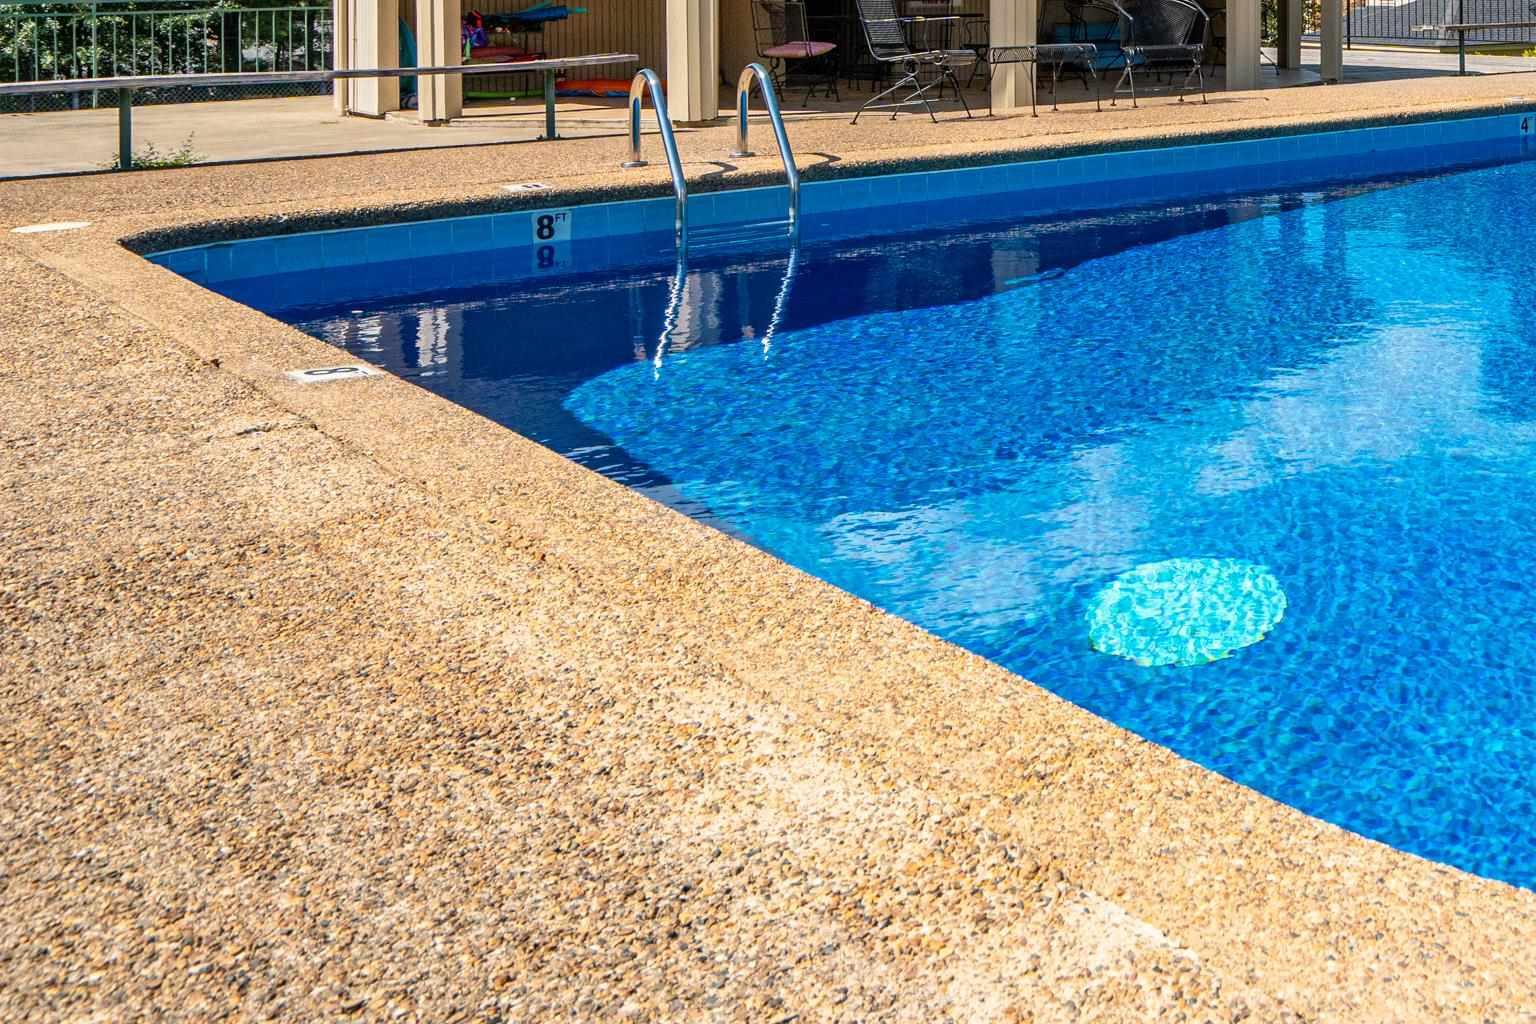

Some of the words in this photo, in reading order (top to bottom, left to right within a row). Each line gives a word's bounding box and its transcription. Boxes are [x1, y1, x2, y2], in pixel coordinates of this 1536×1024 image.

[1521, 118, 1528, 133] 4
[537, 215, 554, 240] 8
[304, 367, 360, 375] 8
